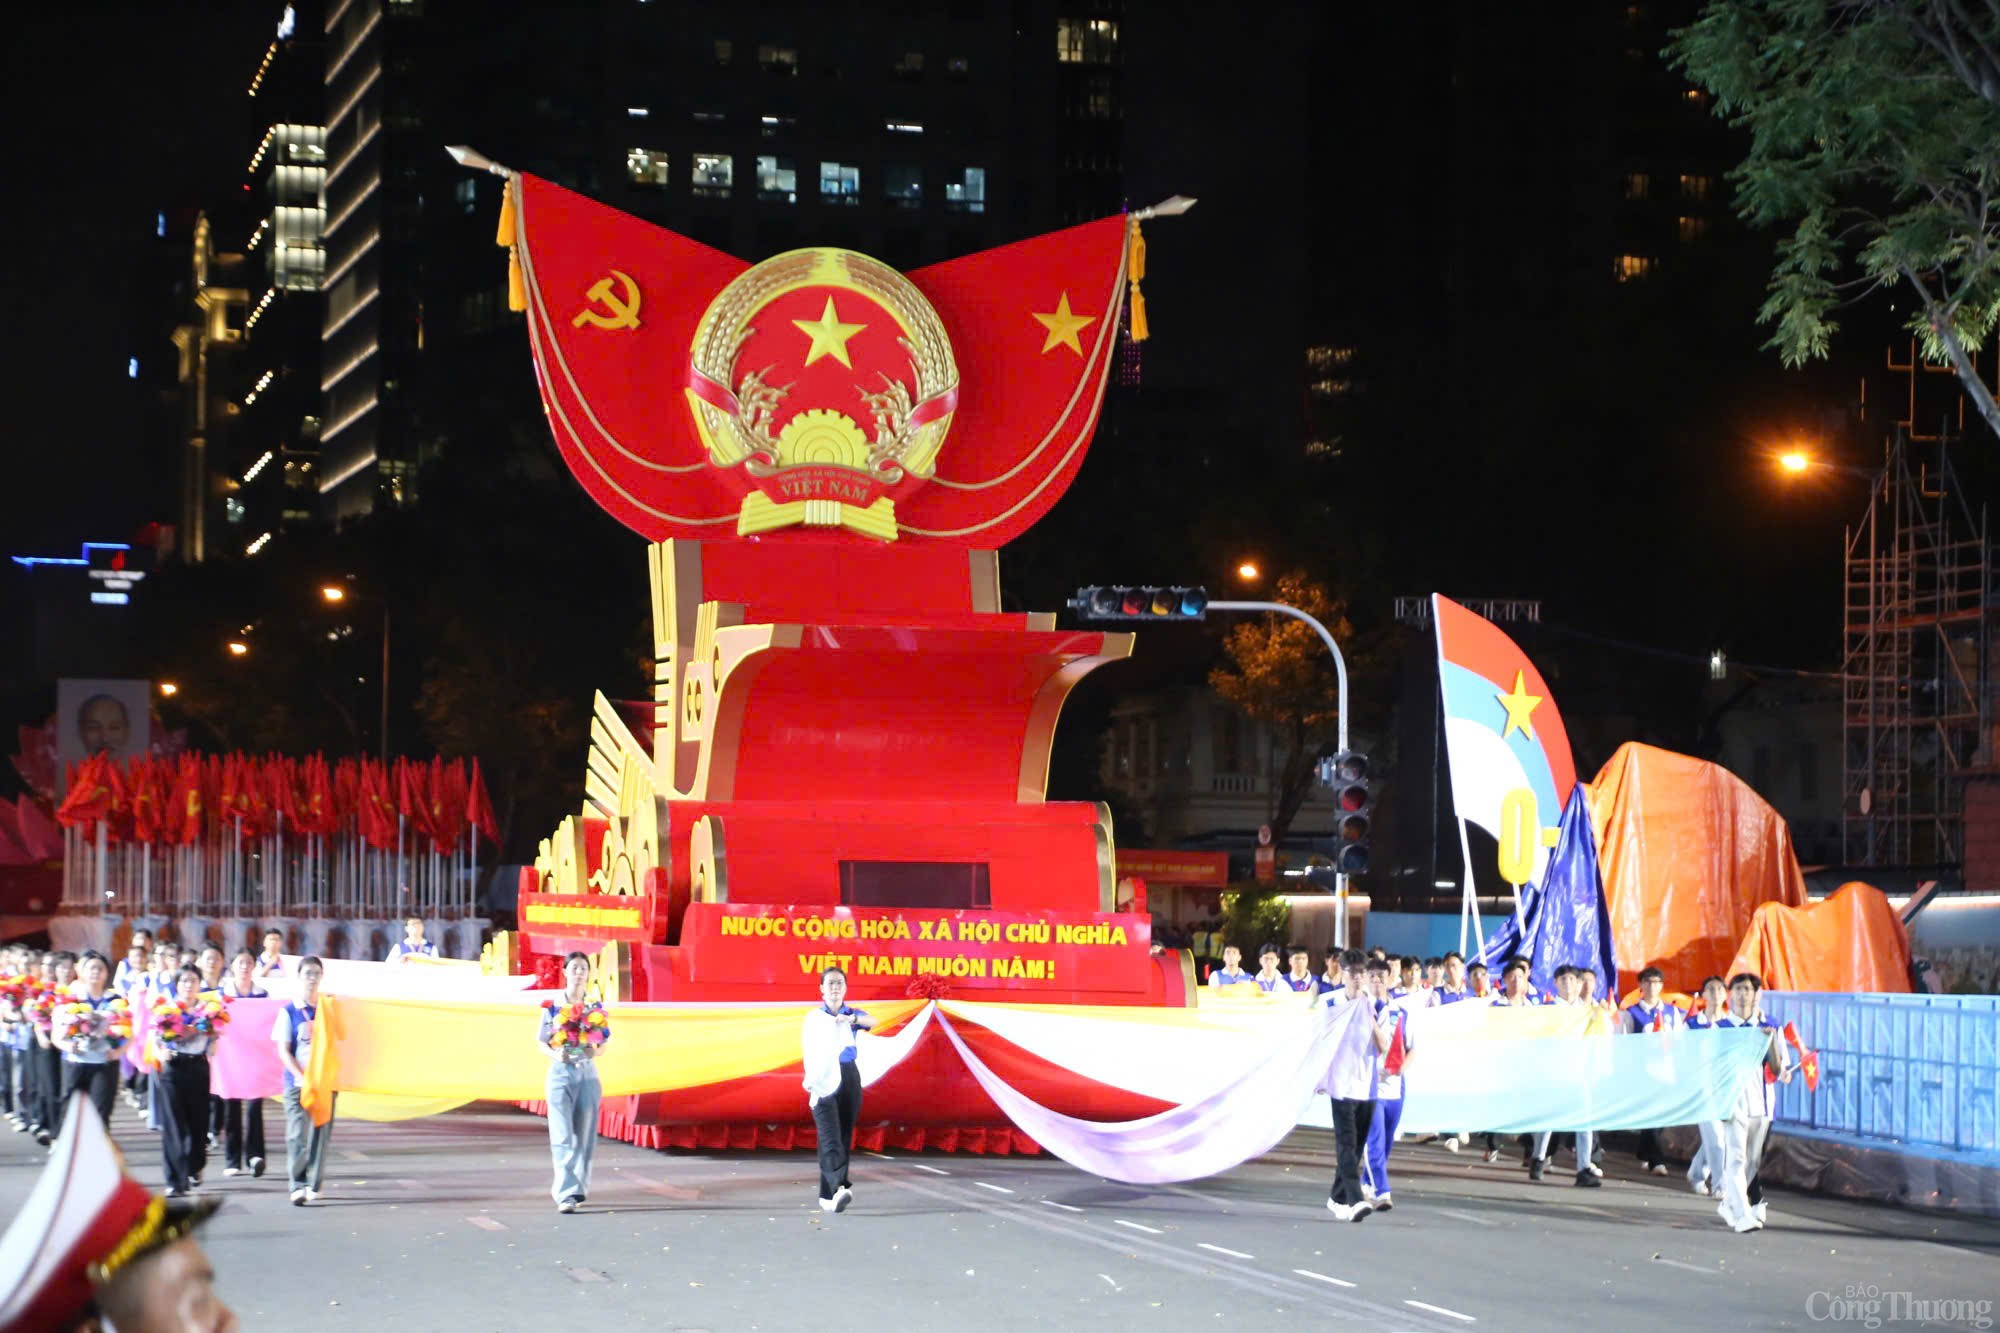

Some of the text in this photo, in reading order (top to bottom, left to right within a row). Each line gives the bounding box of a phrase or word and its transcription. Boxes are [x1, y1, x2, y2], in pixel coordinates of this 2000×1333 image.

[782, 478, 868, 501] VIỆT NAM
[721, 912, 1127, 945] NƯỚC CỘNG HÒA XÃ HỘI CHỦ NGHĨA
[858, 955, 912, 976] NAM
[917, 954, 986, 977] MUÔN
[992, 955, 1055, 979] NĂM!
